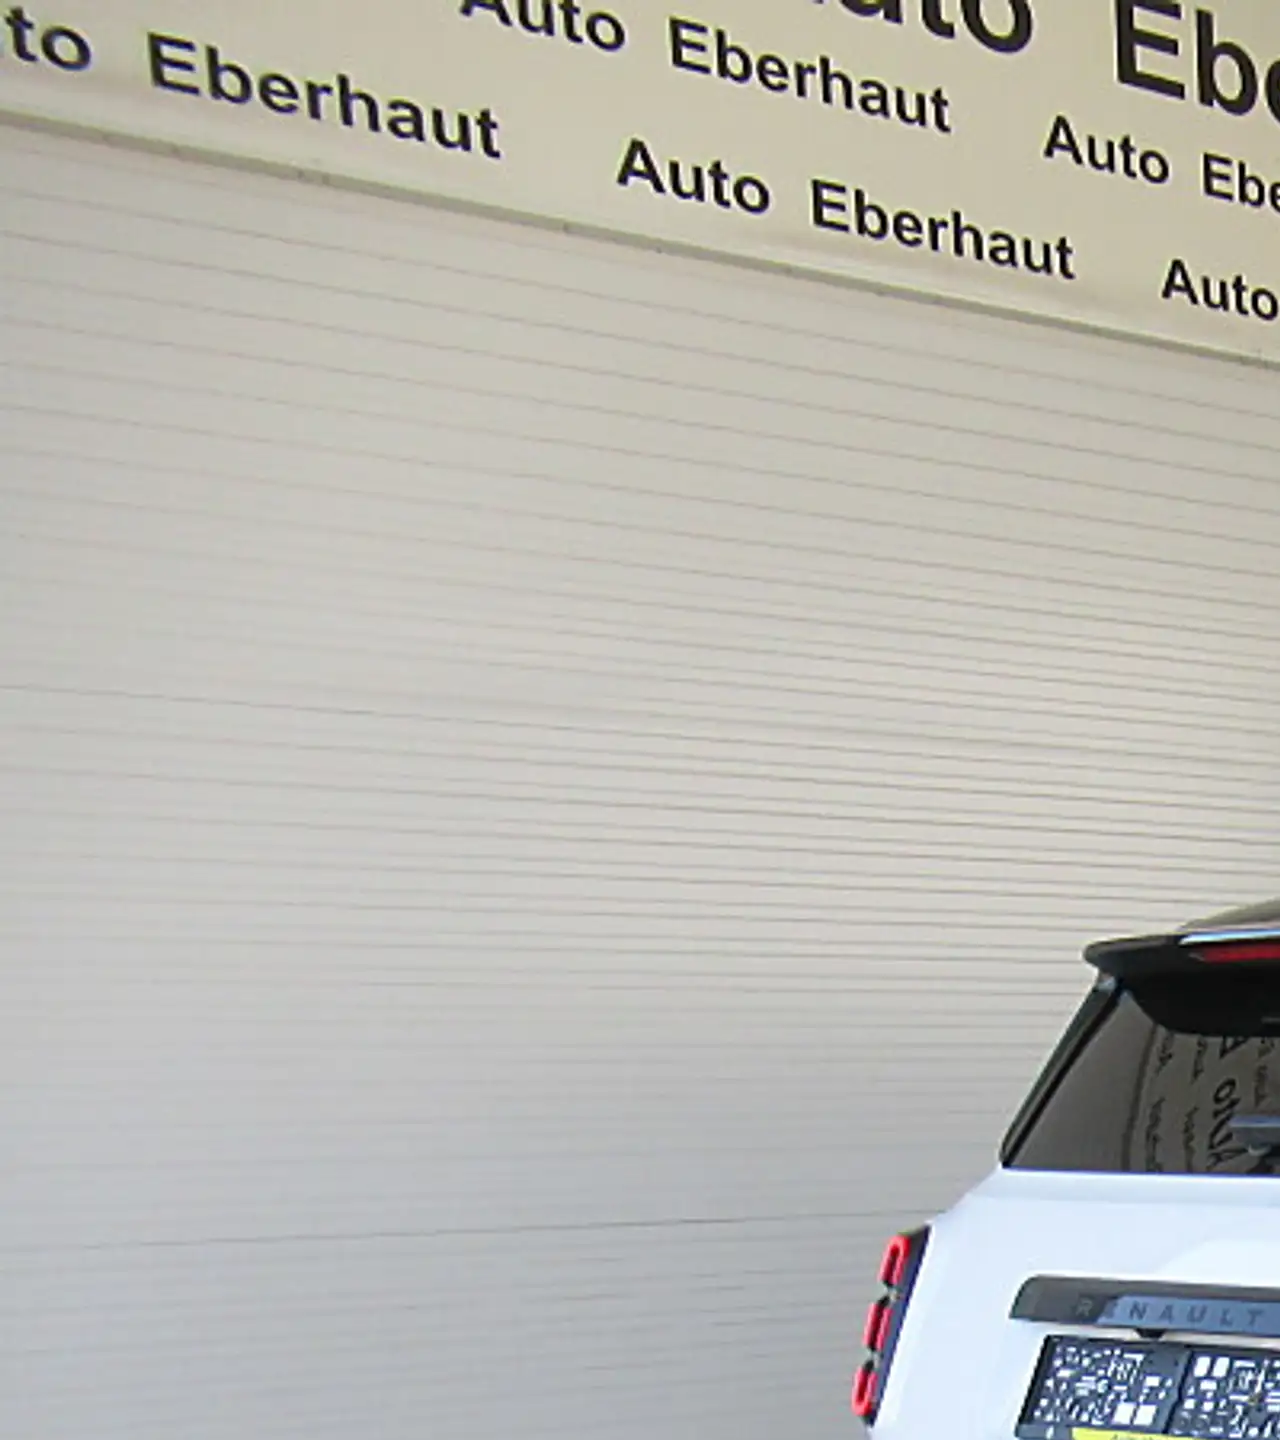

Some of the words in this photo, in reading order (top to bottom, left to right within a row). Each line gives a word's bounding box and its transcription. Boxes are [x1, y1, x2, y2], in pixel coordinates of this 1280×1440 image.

[147, 32, 501, 160] Eberhaut
[669, 17, 950, 135] Eberhaut
[1043, 115, 1170, 184] Auto
[615, 138, 771, 215] Auto
[811, 178, 1076, 281] Eberhaut
[1161, 258, 1280, 322] Auto
